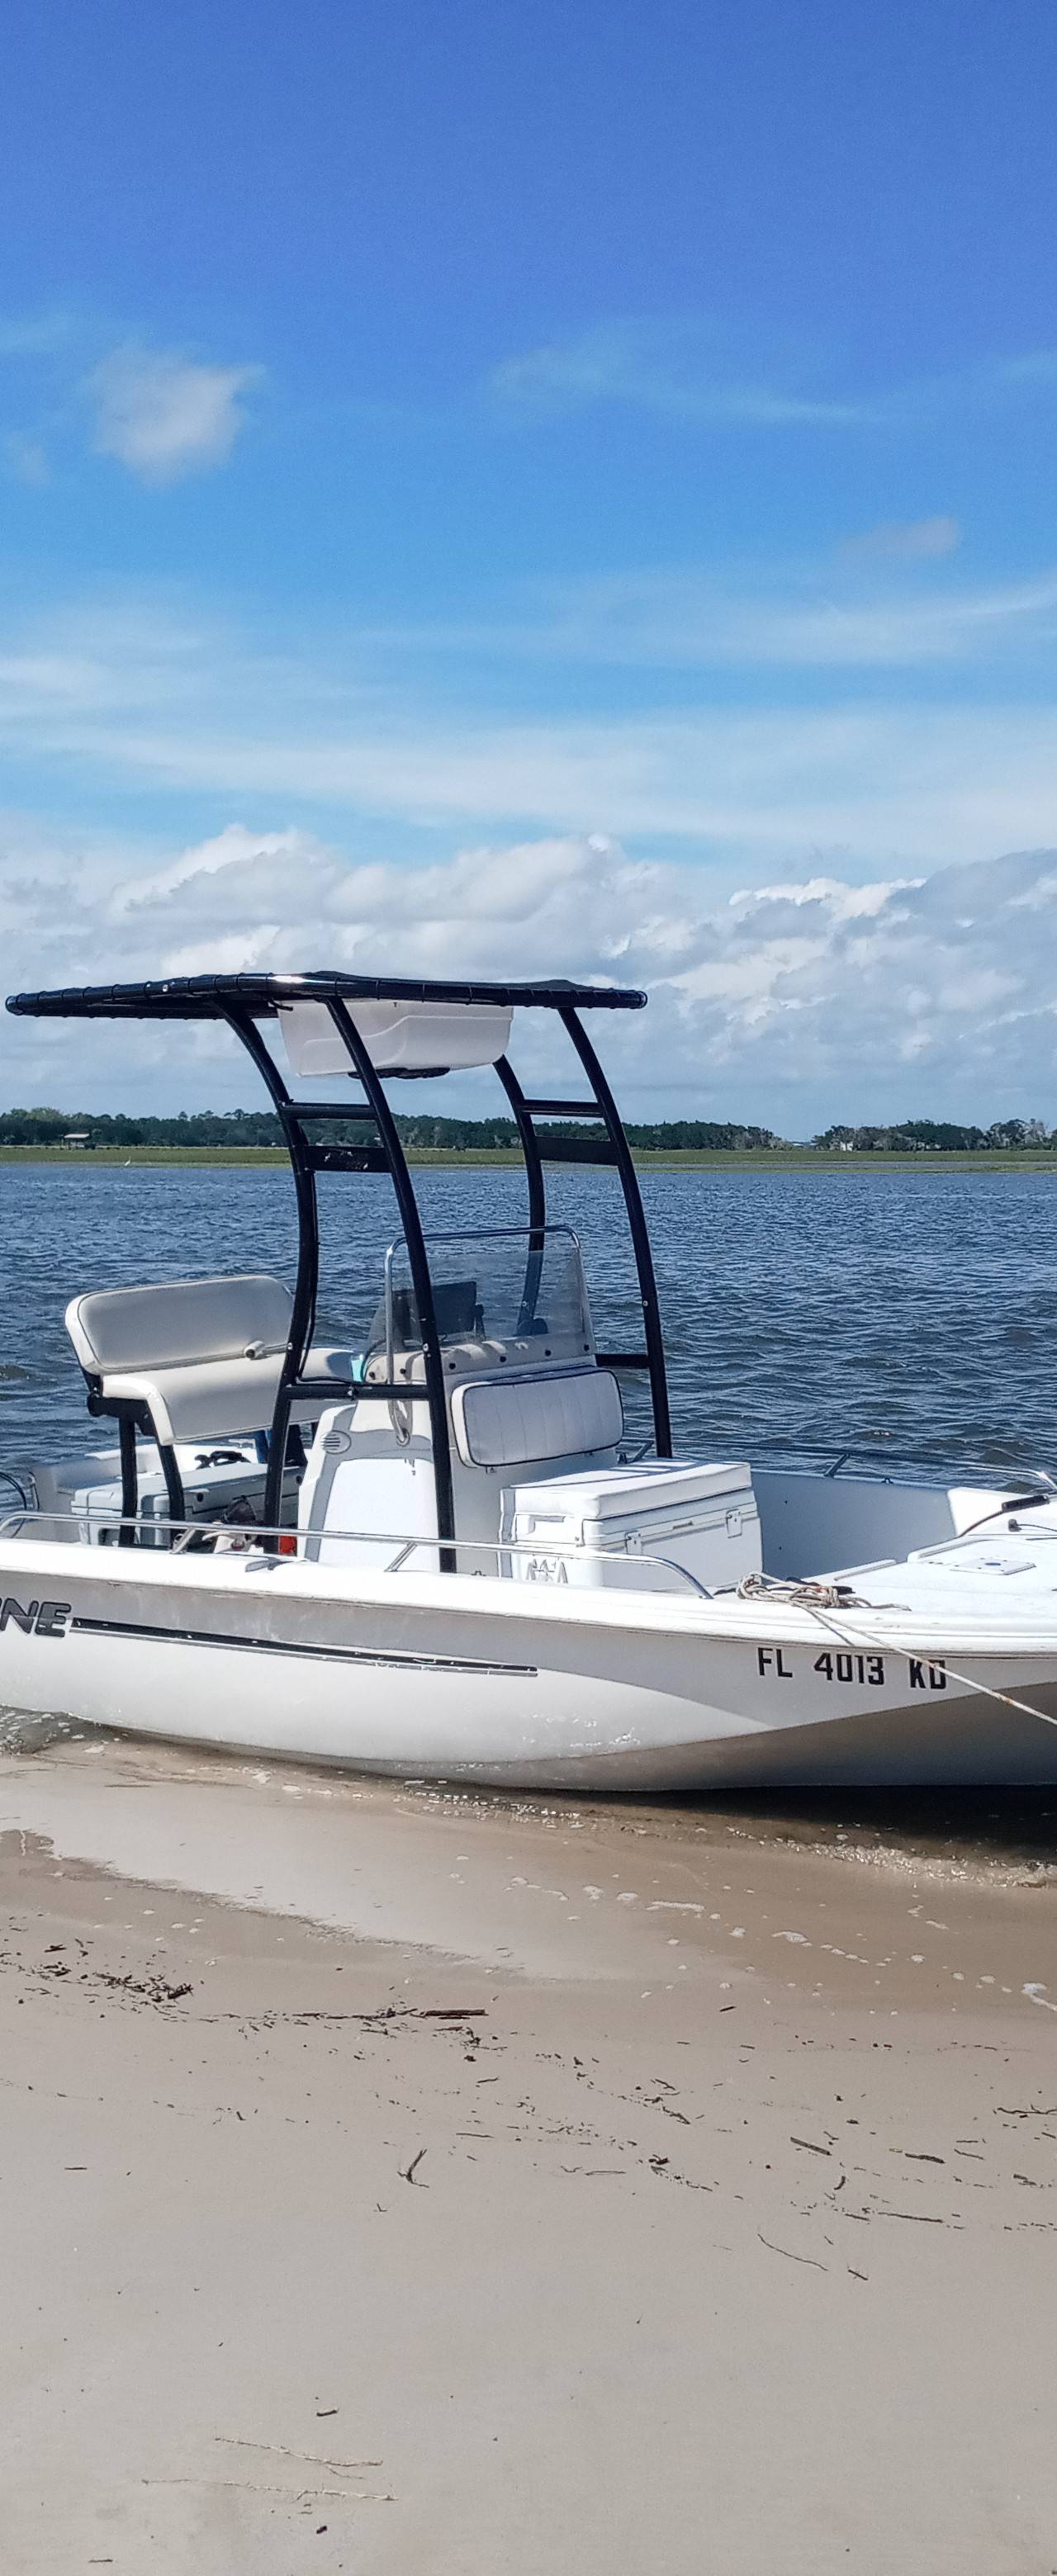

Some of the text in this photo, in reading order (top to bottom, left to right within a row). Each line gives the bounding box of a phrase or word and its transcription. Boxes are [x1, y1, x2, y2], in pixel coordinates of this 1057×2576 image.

[0, 1598, 72, 1638] NE
[757, 1647, 793, 1678] FL
[813, 1652, 884, 1685] 4013
